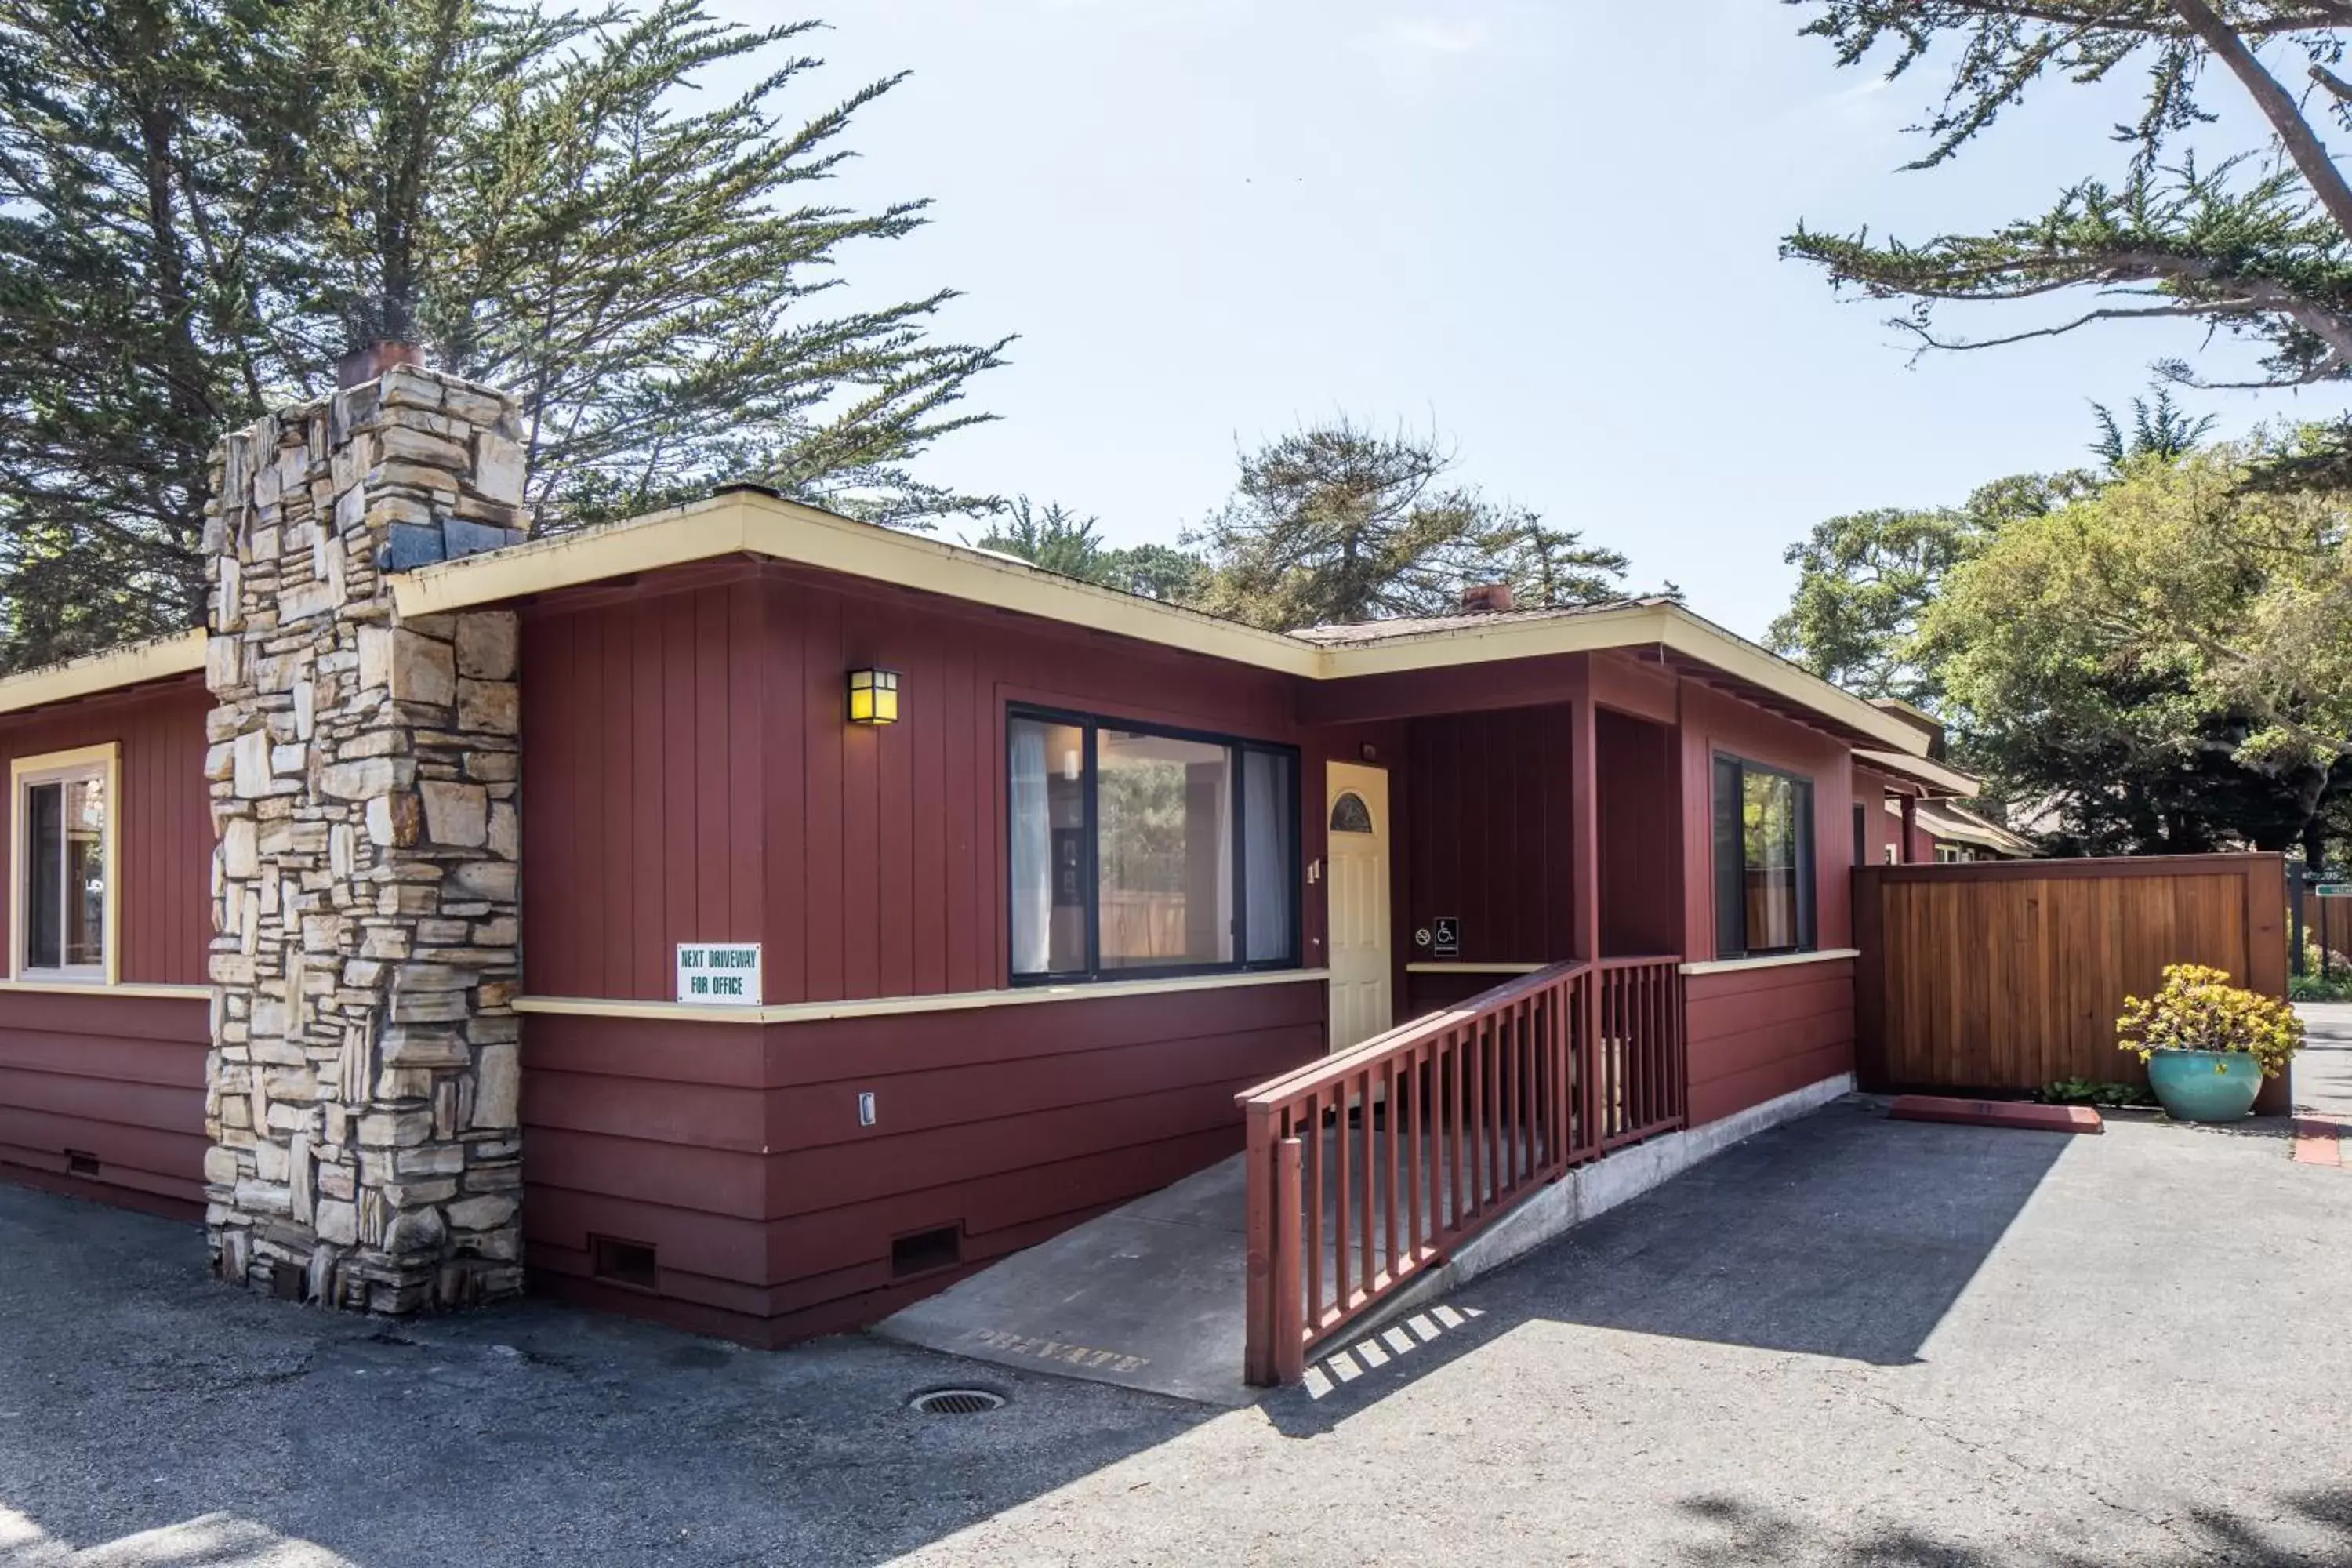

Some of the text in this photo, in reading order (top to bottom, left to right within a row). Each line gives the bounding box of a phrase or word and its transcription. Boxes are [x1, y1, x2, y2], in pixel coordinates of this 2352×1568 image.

[681, 950, 757, 968] NEXT DRIVEWAY
[691, 976, 743, 995] FOR OFFICE
